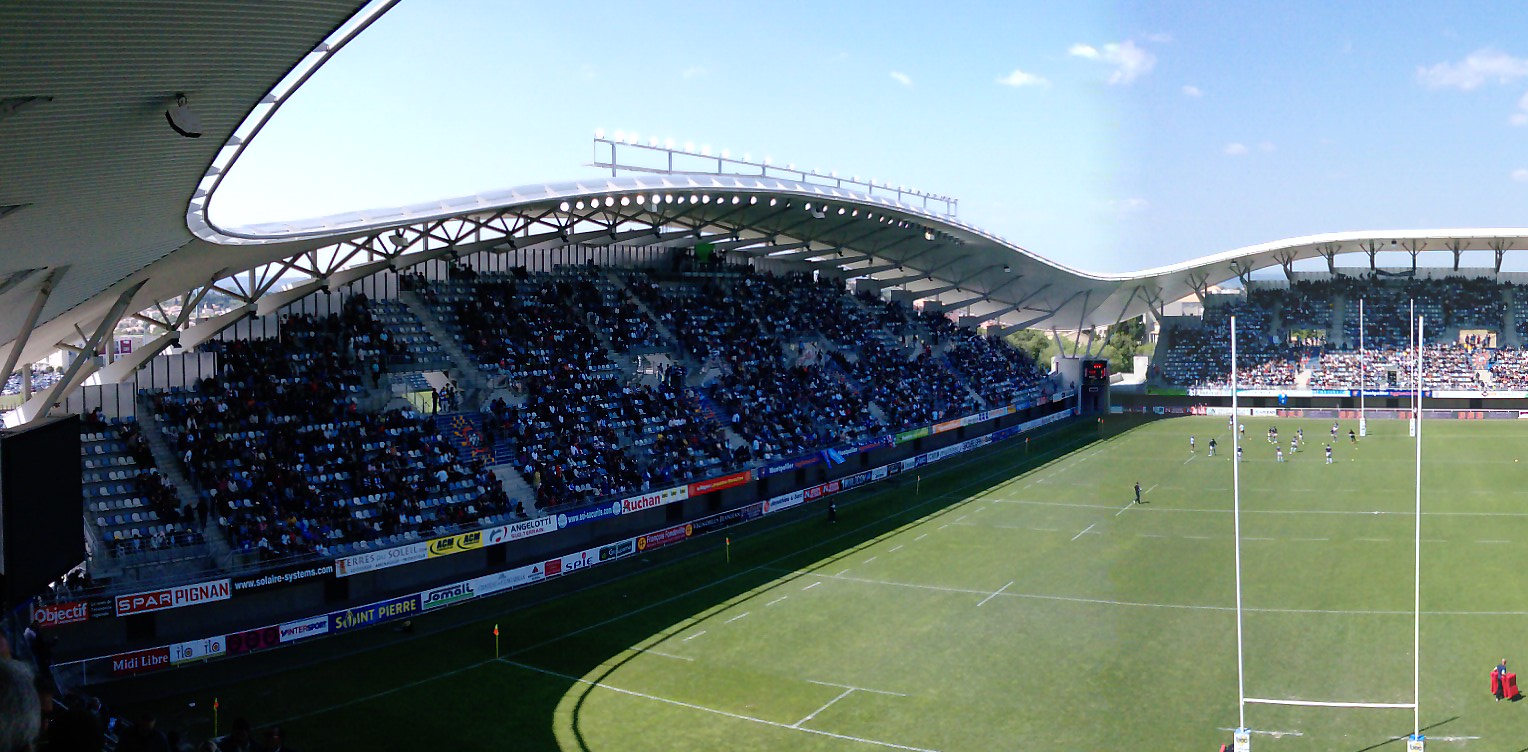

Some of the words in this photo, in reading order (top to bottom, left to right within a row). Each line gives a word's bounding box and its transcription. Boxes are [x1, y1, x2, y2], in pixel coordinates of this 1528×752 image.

[623, 495, 661, 514] Auchan
[511, 516, 551, 533] ANGELOTTI
[437, 537, 454, 549] ACM
[464, 531, 481, 544] ACM
[234, 564, 334, 591] www.solaire-systems.com
[118, 592, 172, 612] SPAR
[176, 582, 229, 605] PIGNAN
[35, 602, 88, 625] Objectif
[378, 600, 417, 619] PIERRE
[113, 657, 138, 672] Midi
[141, 653, 169, 667] Libre
